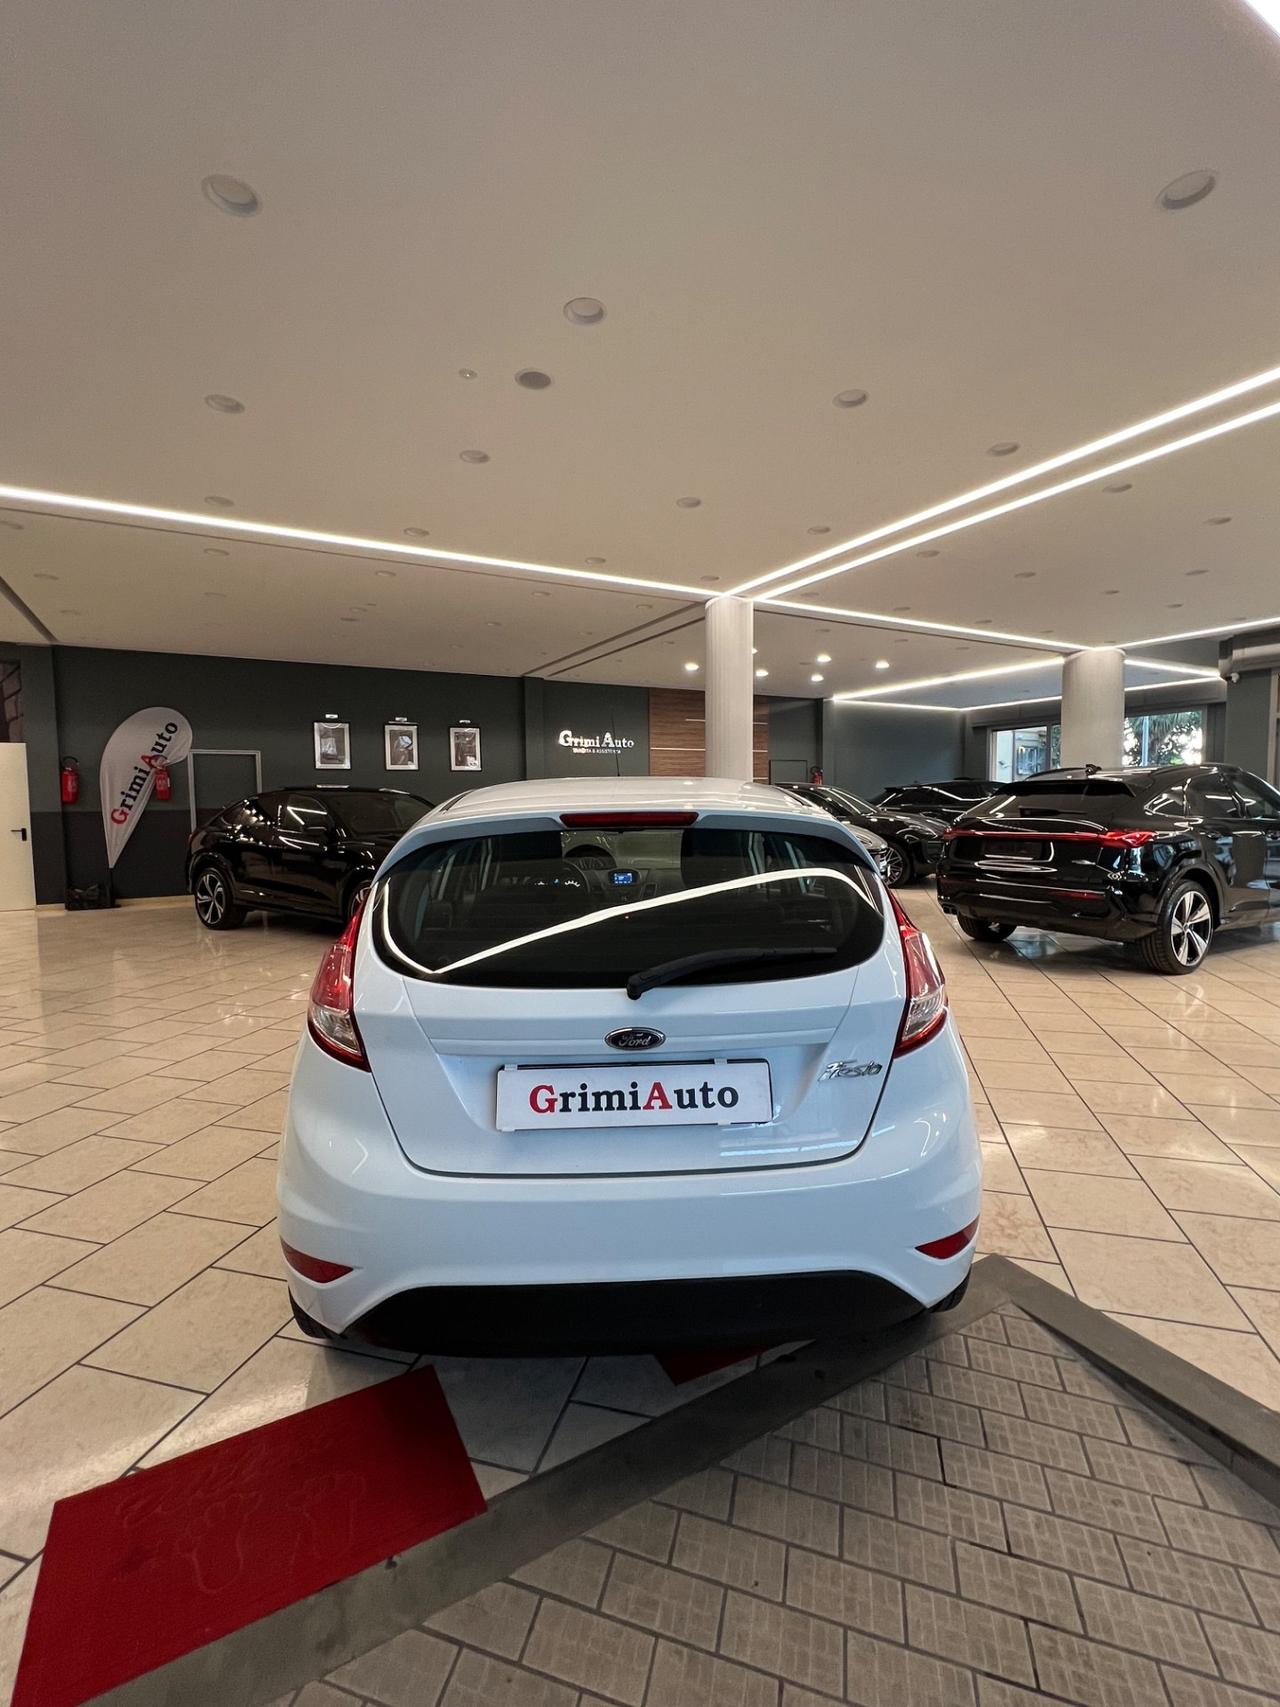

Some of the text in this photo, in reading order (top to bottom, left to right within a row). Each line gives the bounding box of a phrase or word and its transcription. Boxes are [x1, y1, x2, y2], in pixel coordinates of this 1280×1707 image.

[559, 730, 635, 748] Grimi Auto
[111, 721, 178, 825] GrimiAuto
[618, 1032, 652, 1047] Ford
[529, 1081, 739, 1114] GrimiAuto
